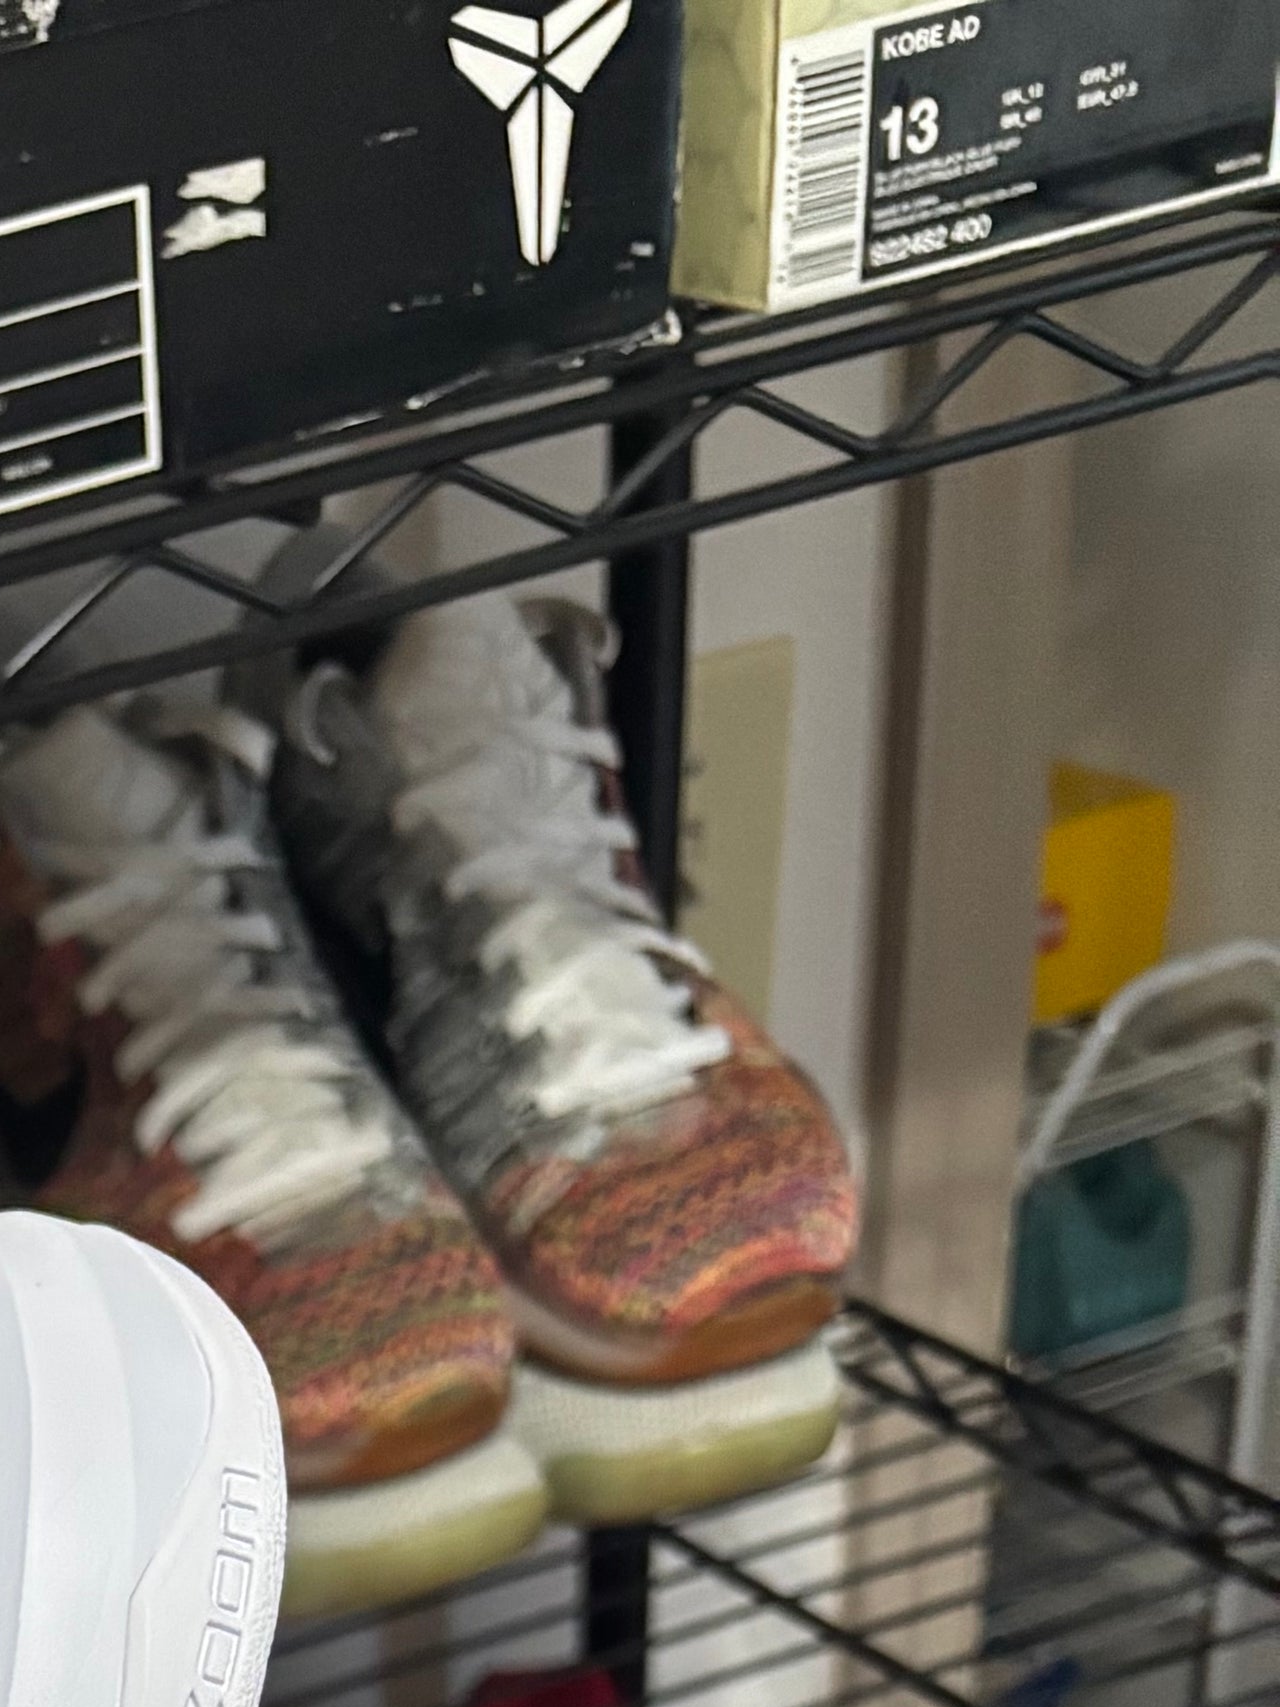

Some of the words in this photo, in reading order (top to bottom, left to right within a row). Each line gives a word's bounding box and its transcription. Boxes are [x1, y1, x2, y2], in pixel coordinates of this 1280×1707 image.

[881, 27, 943, 61] KOBE
[945, 15, 981, 44] AD
[880, 96, 939, 161] 13
